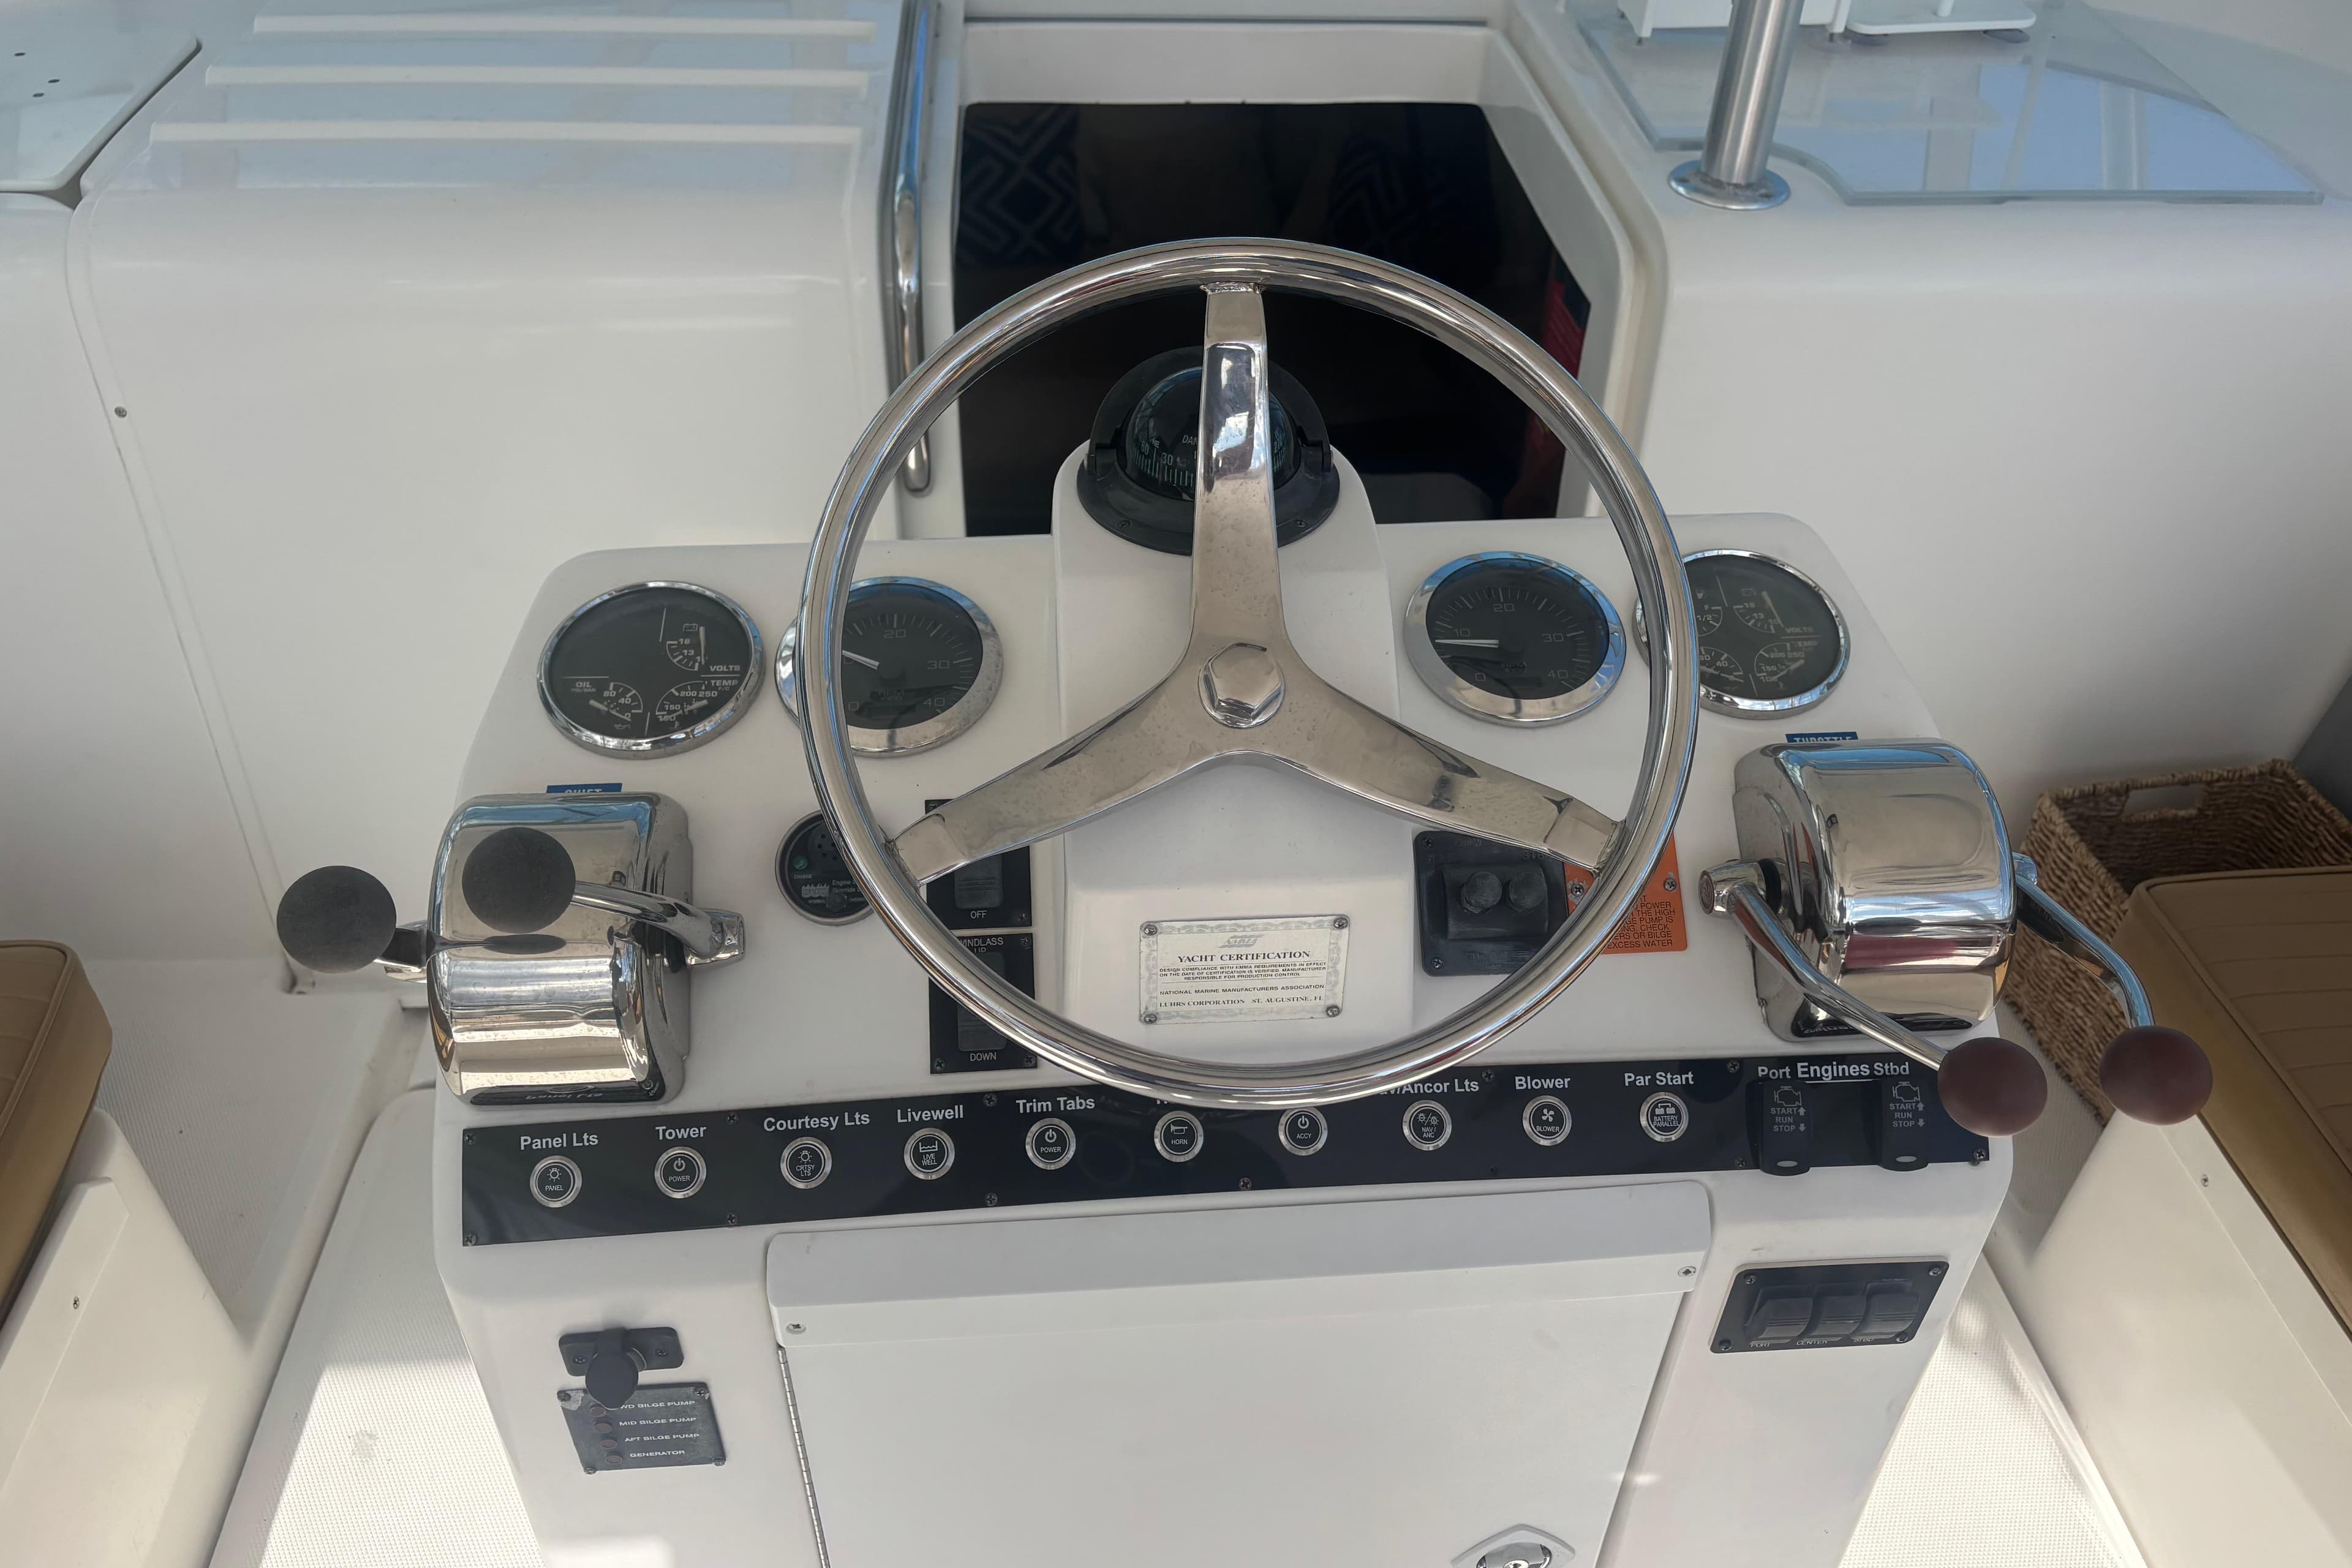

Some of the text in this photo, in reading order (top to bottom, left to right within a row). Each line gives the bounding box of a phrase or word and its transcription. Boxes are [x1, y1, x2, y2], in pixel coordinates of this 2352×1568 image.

[1141, 441, 1149, 455] 60
[1161, 452, 1173, 466] 30
[1493, 603, 1515, 612] 20
[884, 630, 906, 638] 20
[1541, 633, 1564, 642] 30
[927, 660, 949, 669] 30
[1475, 673, 1486, 681] 0
[1548, 670, 1568, 679] 40
[848, 701, 859, 710] 0
[923, 698, 945, 706] 40
[970, 910, 987, 919] OFF
[1178, 951, 1310, 963] YACHT CERTIFICATION
[970, 1052, 997, 1061] DOWN
[1758, 1061, 1910, 1080] Port Engines Stbd
[1515, 1076, 1570, 1090] Blower
[1624, 1071, 1694, 1087] Par Start
[1455, 1079, 1479, 1092] Lts
[1016, 1096, 1095, 1114] Trim Tabs
[897, 1104, 963, 1123] Livewell
[763, 1112, 870, 1132] Courtesy Lts
[655, 1126, 706, 1140] Tower
[521, 1133, 598, 1150] Panel Lts
